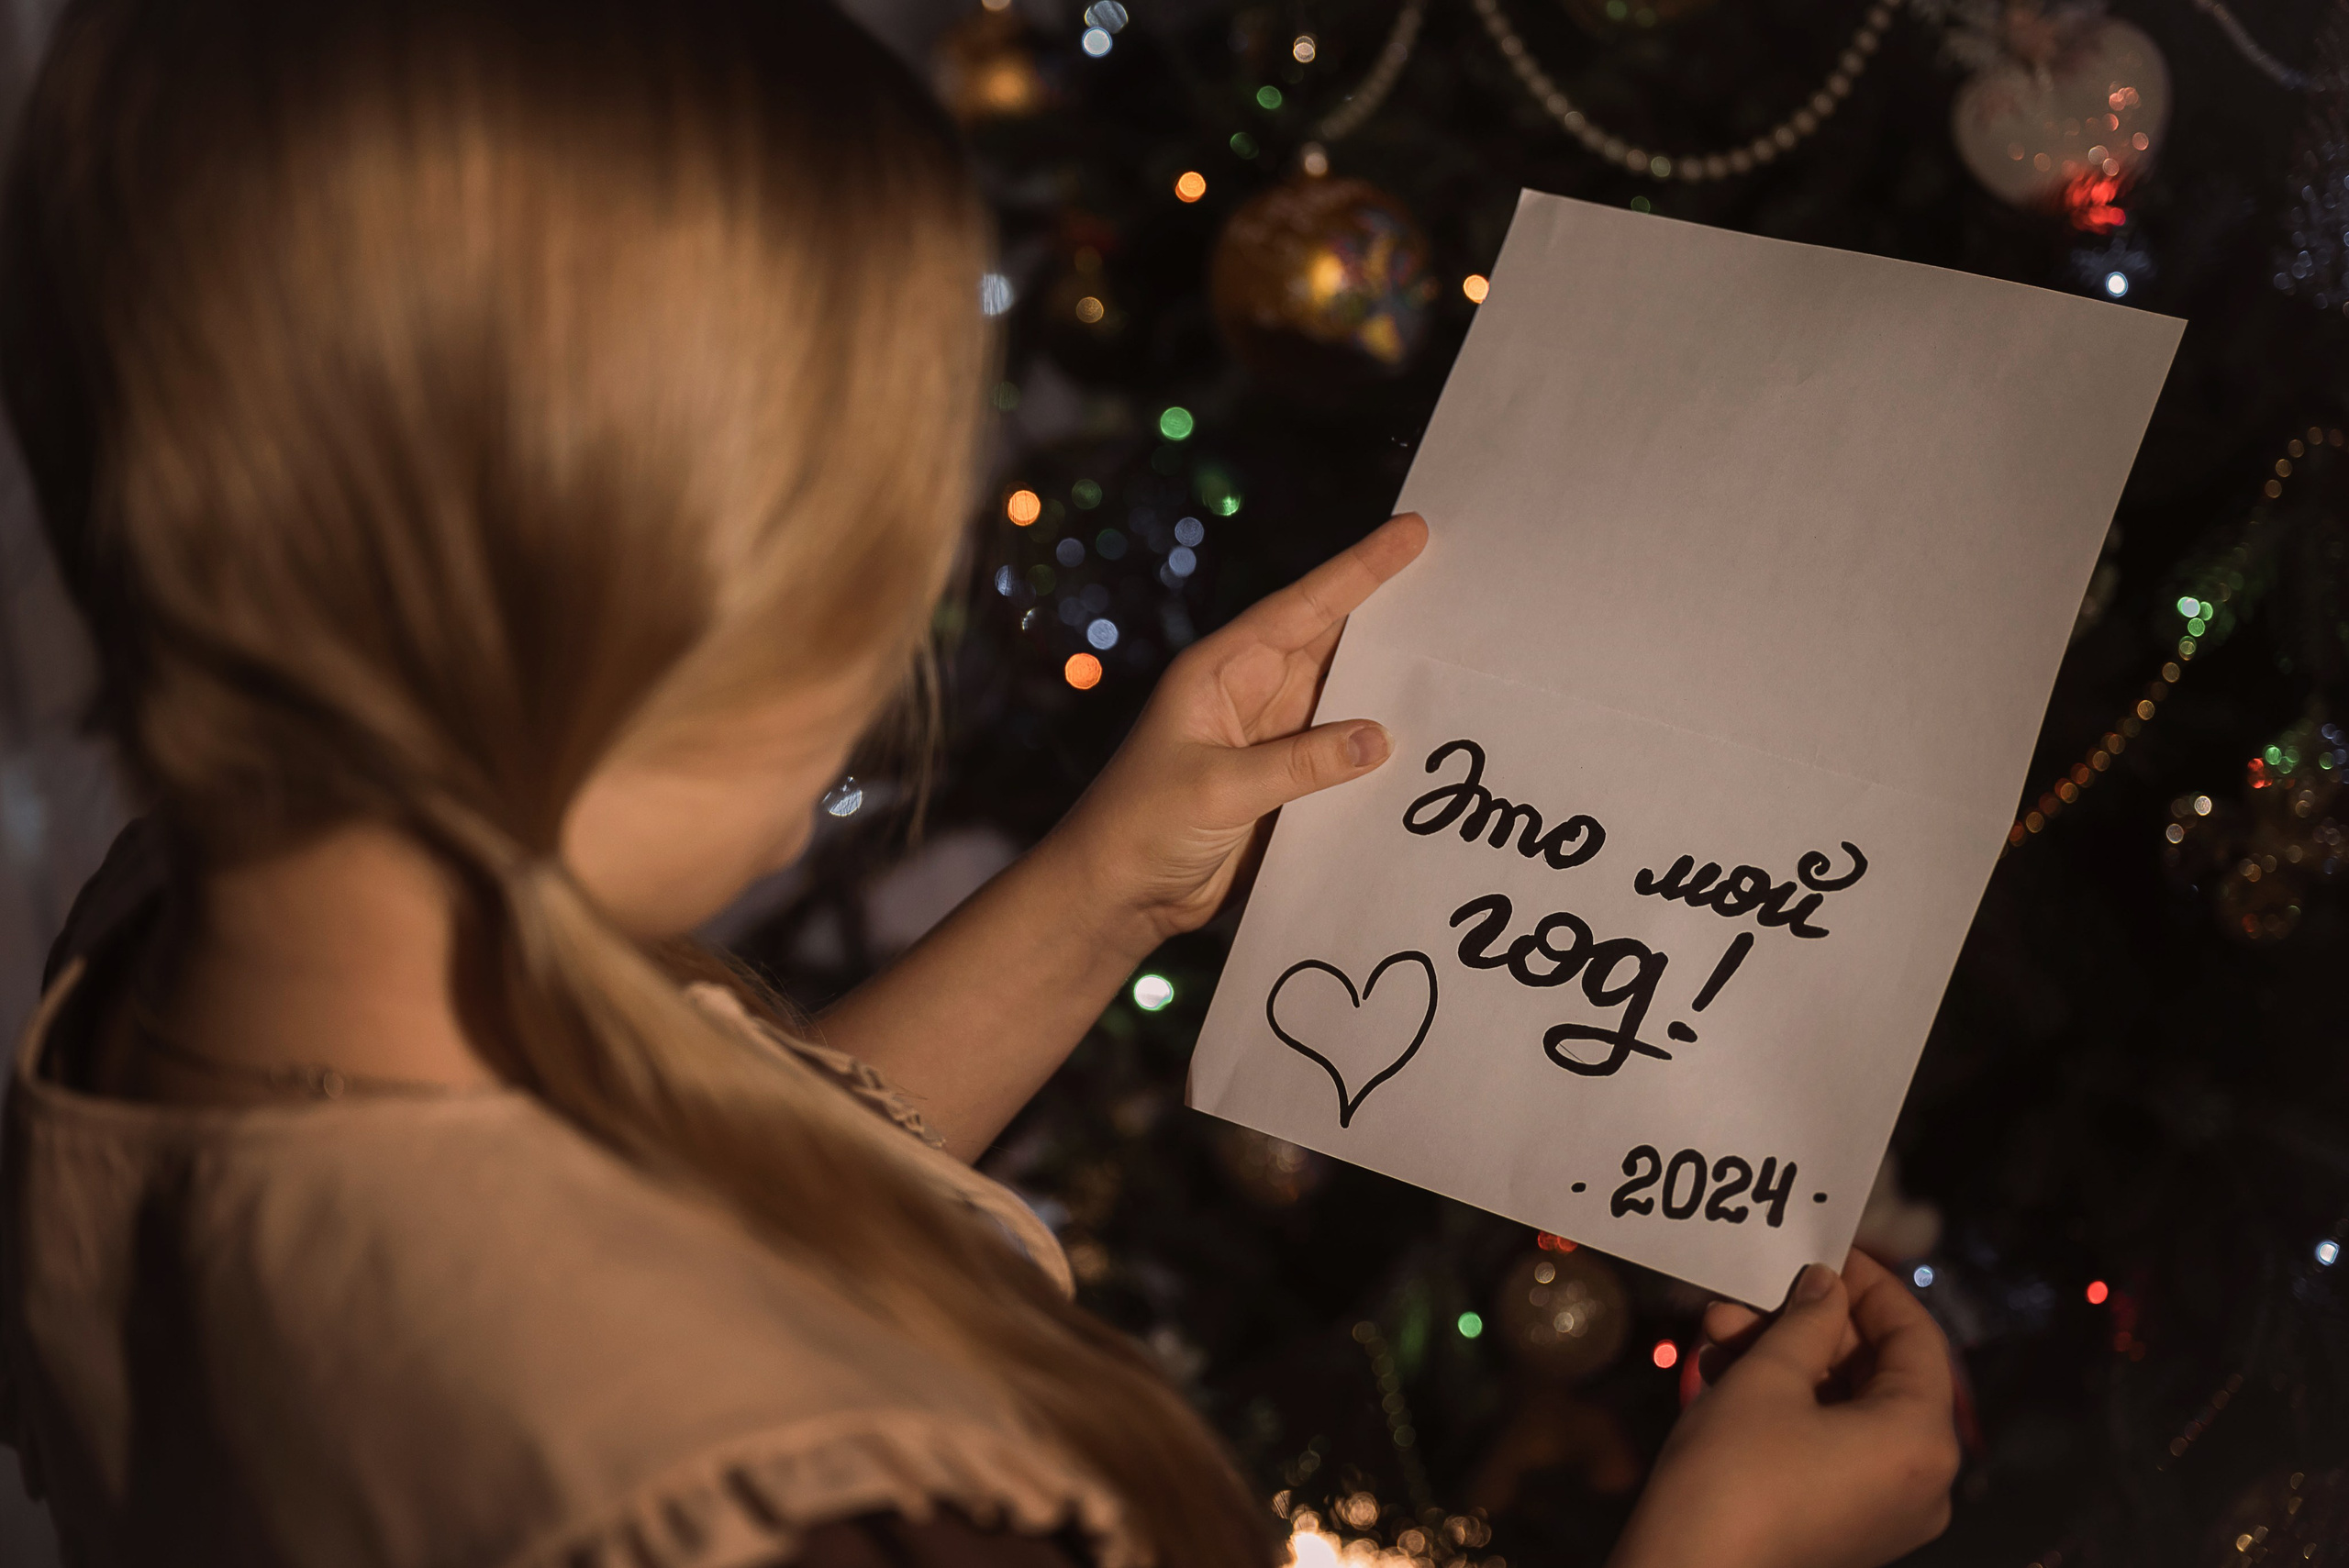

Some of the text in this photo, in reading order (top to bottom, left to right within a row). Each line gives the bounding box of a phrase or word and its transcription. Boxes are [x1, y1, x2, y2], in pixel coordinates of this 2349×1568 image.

[1402, 739, 1869, 939] Это мой
[1449, 894, 1754, 1077] год!
[1609, 1144, 1798, 1229] 2024
